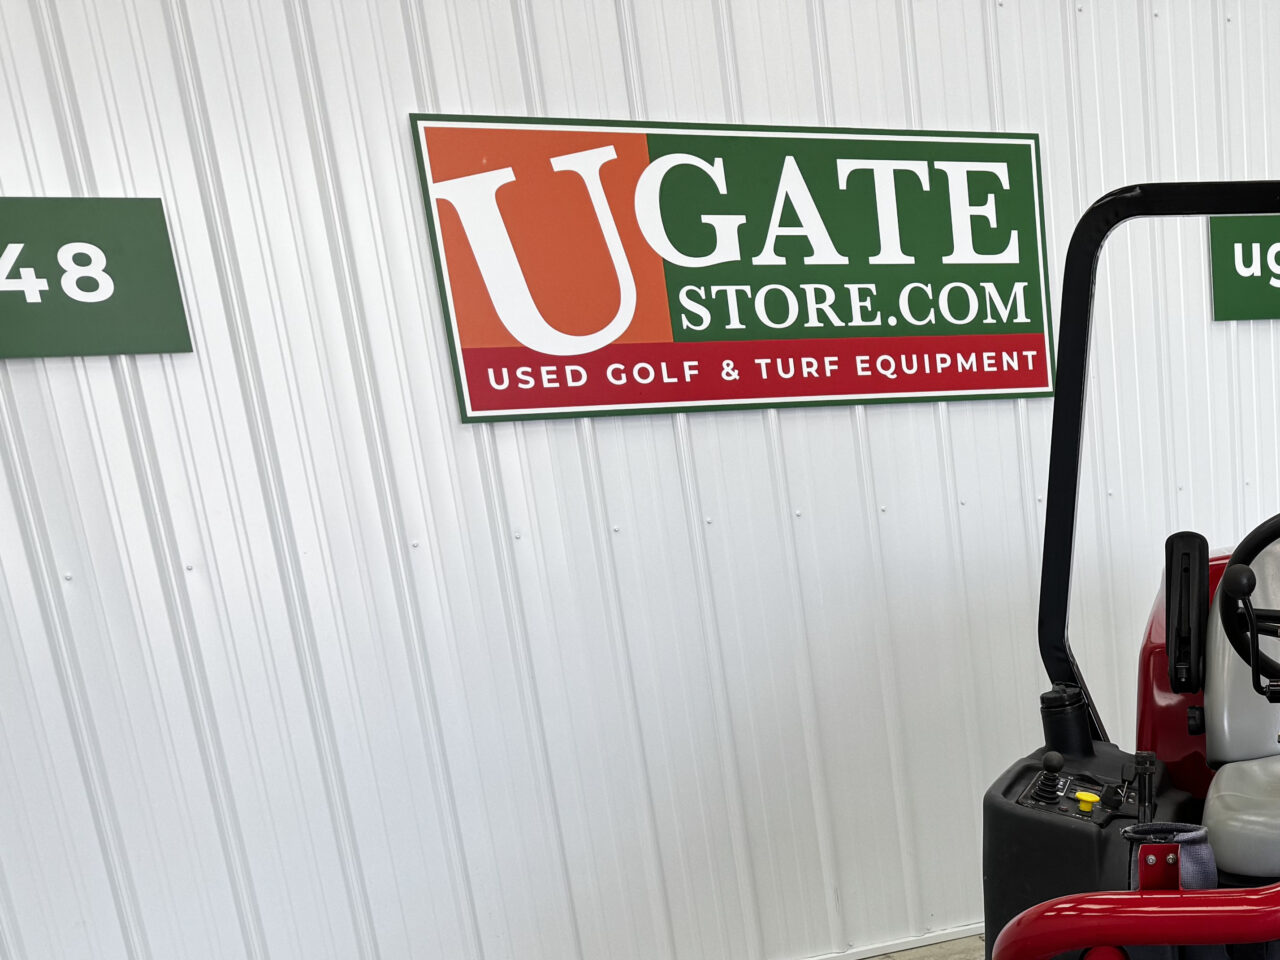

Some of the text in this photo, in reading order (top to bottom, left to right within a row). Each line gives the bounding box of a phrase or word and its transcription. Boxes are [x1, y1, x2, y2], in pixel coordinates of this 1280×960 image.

[0, 242, 115, 303] 48
[680, 281, 1032, 331] STORE.COM
[487, 350, 1038, 391] USED GOLF & TURF EQUIPMENT
